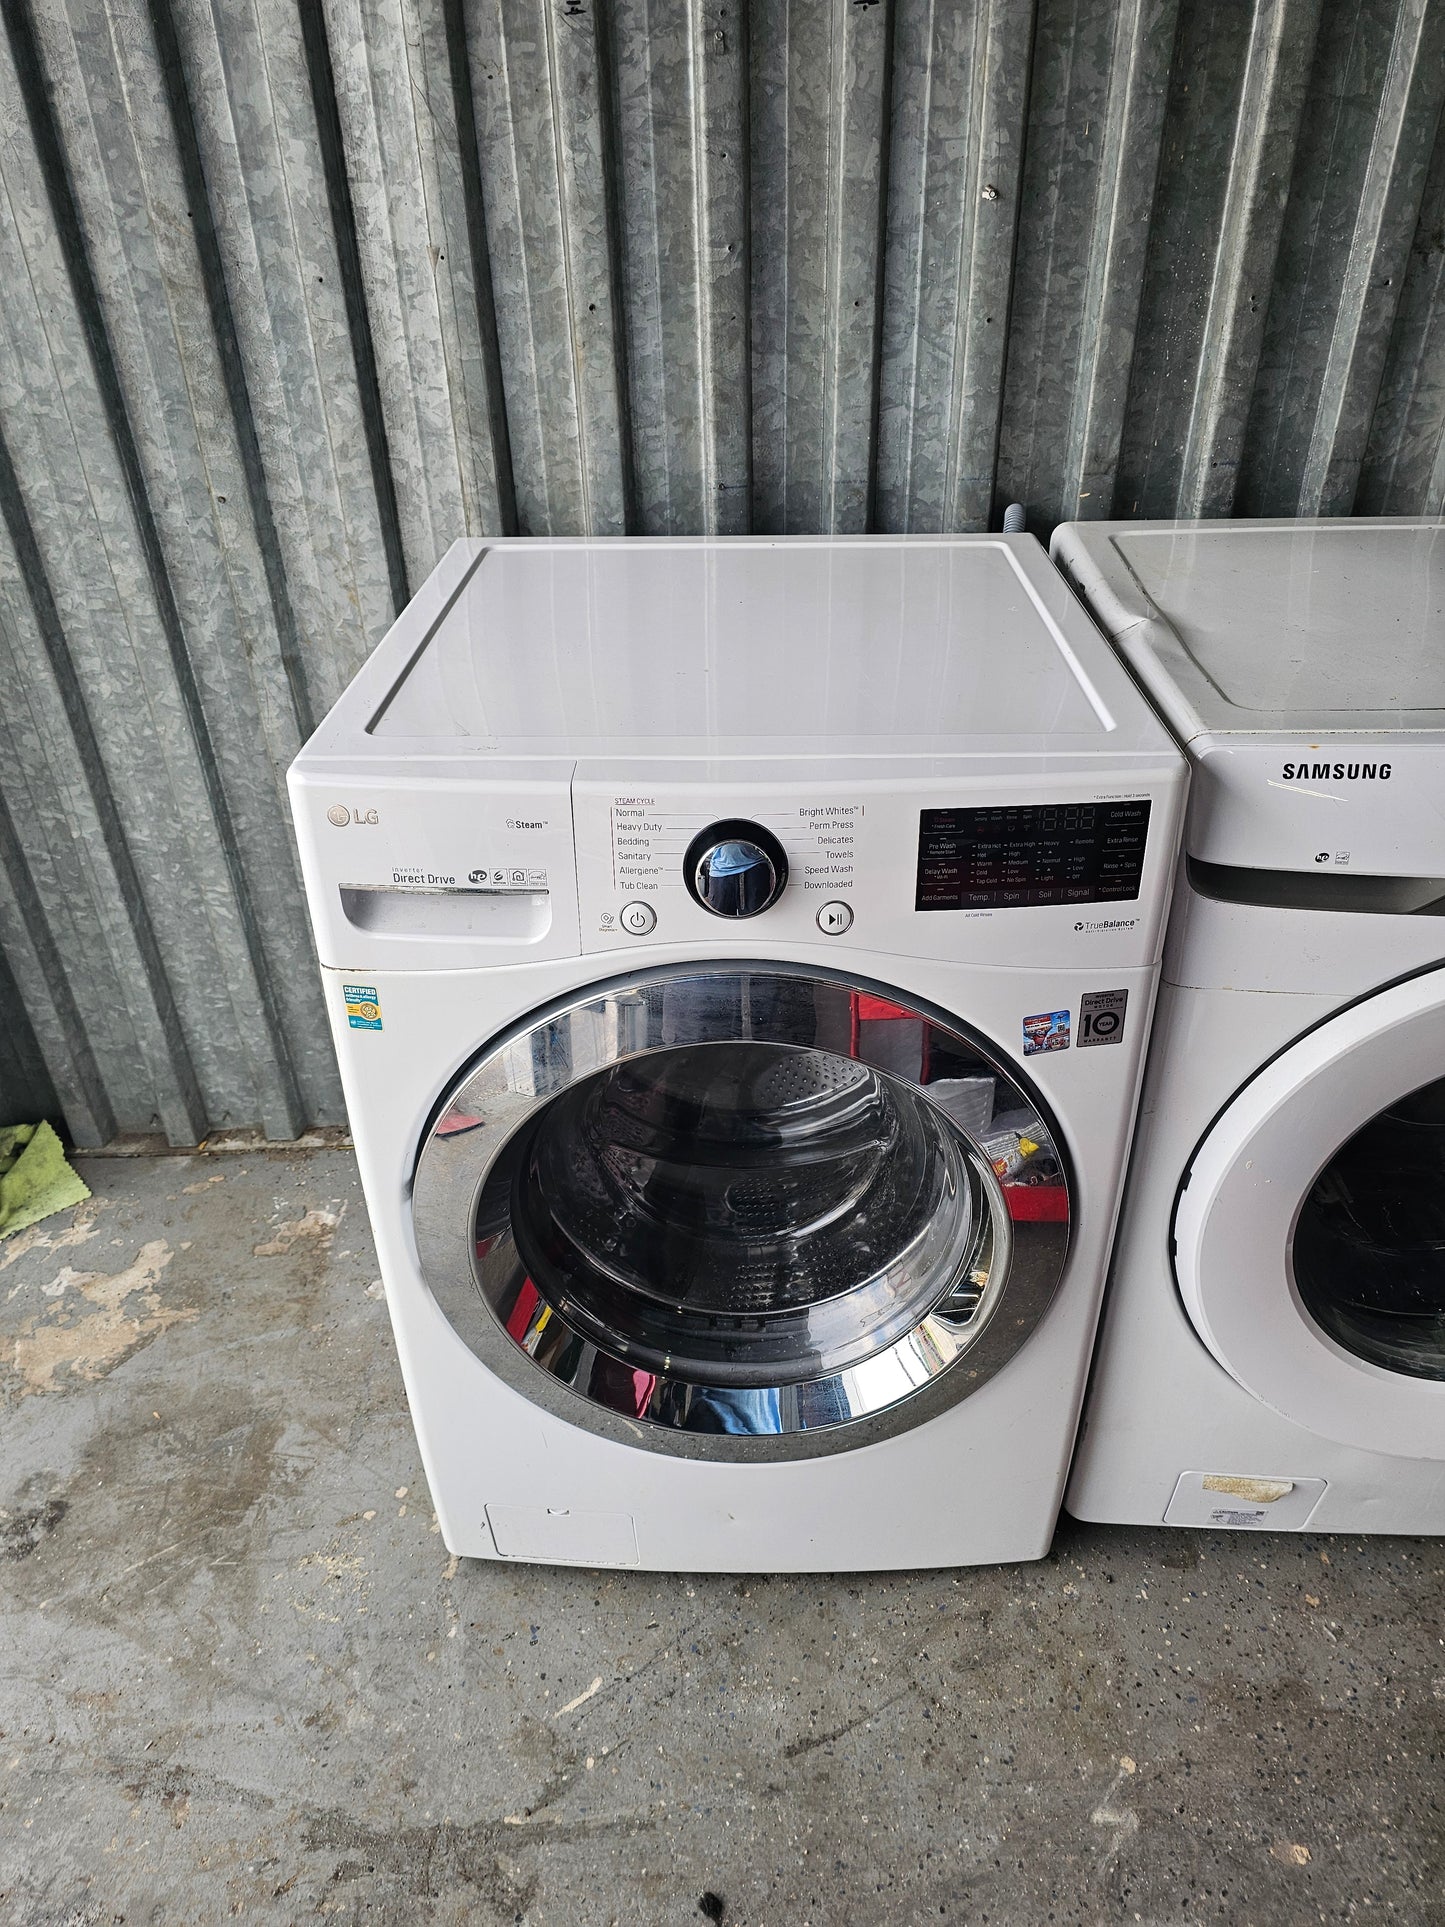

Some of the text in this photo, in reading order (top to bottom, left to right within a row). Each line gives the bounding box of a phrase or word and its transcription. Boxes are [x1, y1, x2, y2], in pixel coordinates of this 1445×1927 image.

[1282, 764, 1392, 780] SAMSUNG
[353, 808, 379, 824] LG
[616, 808, 644, 816] Normal
[800, 808, 824, 817] Bright
[616, 822, 662, 832] Heavy Duty
[810, 822, 830, 830] Perm
[618, 838, 650, 847] Bedding
[818, 836, 854, 844] Delicates
[618, 852, 651, 861] Sanitary
[825, 850, 854, 858] Towels
[804, 866, 830, 875] Speed
[393, 873, 456, 884] Direct Drive
[620, 882, 658, 890] Tub Clean
[804, 880, 853, 889] Downloaded
[968, 893, 990, 902] Temp.
[1004, 892, 1020, 901] Spin
[1038, 890, 1052, 899] Soil
[1067, 888, 1090, 898] Signal
[344, 986, 376, 995] CERTIFIED
[1084, 1012, 1120, 1037] 10
